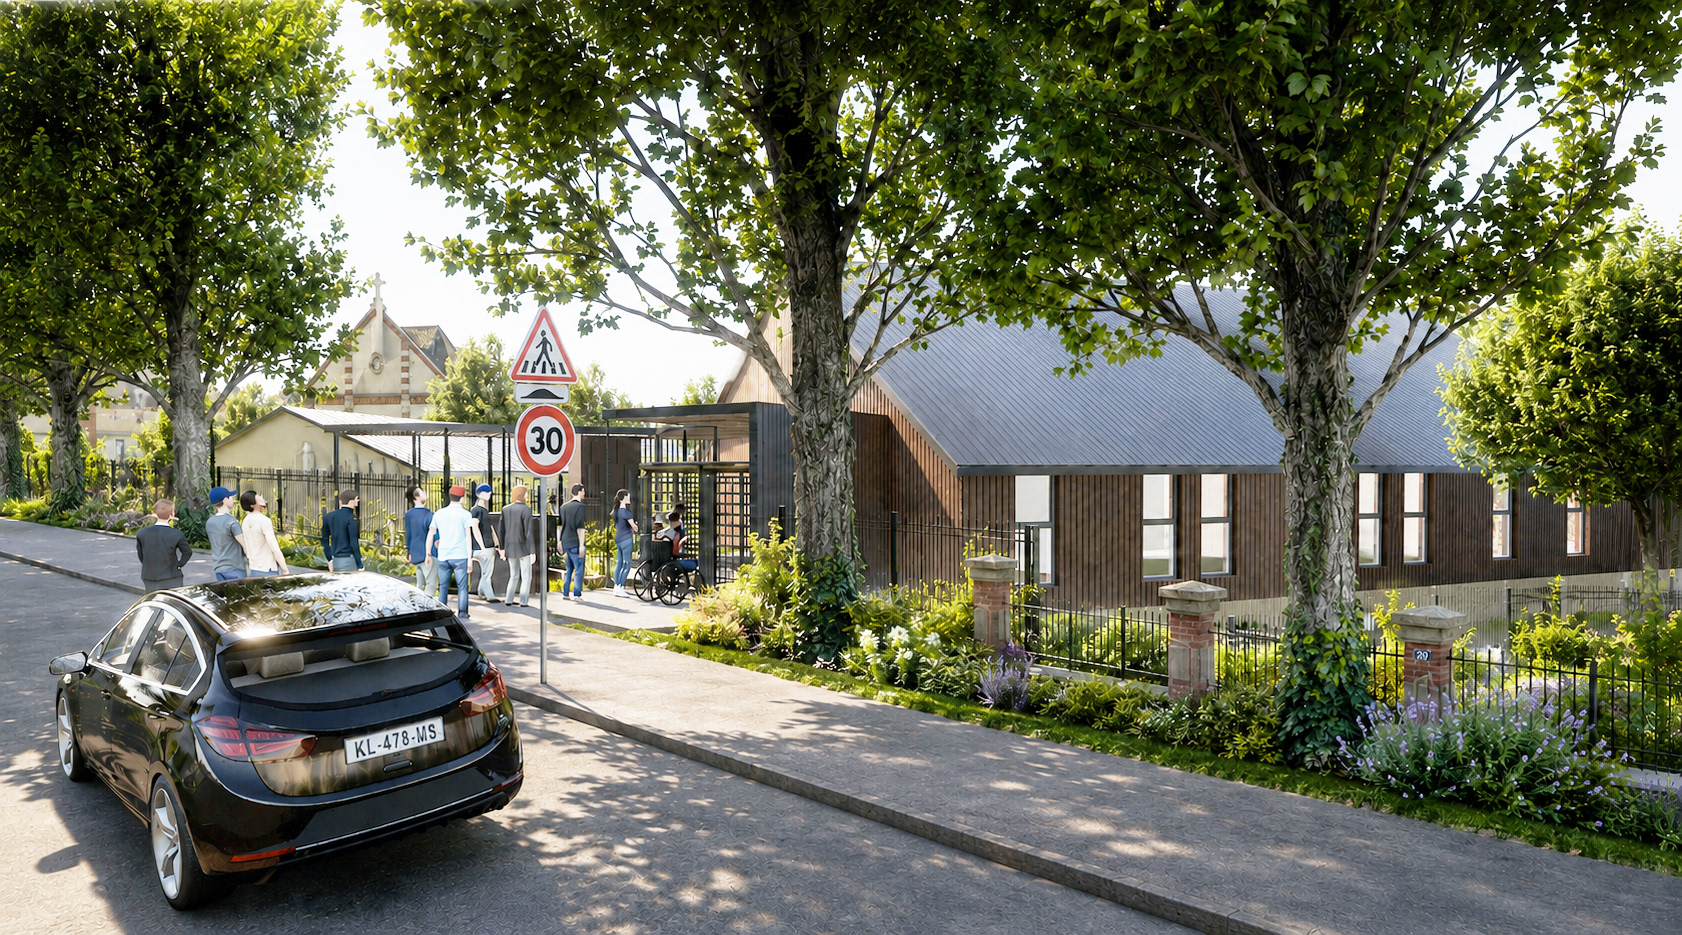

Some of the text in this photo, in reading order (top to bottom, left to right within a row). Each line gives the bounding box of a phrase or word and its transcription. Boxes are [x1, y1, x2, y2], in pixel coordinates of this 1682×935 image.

[530, 426, 563, 455] 30
[1416, 650, 1429, 661] 29
[354, 723, 437, 758] KL-478-MS
